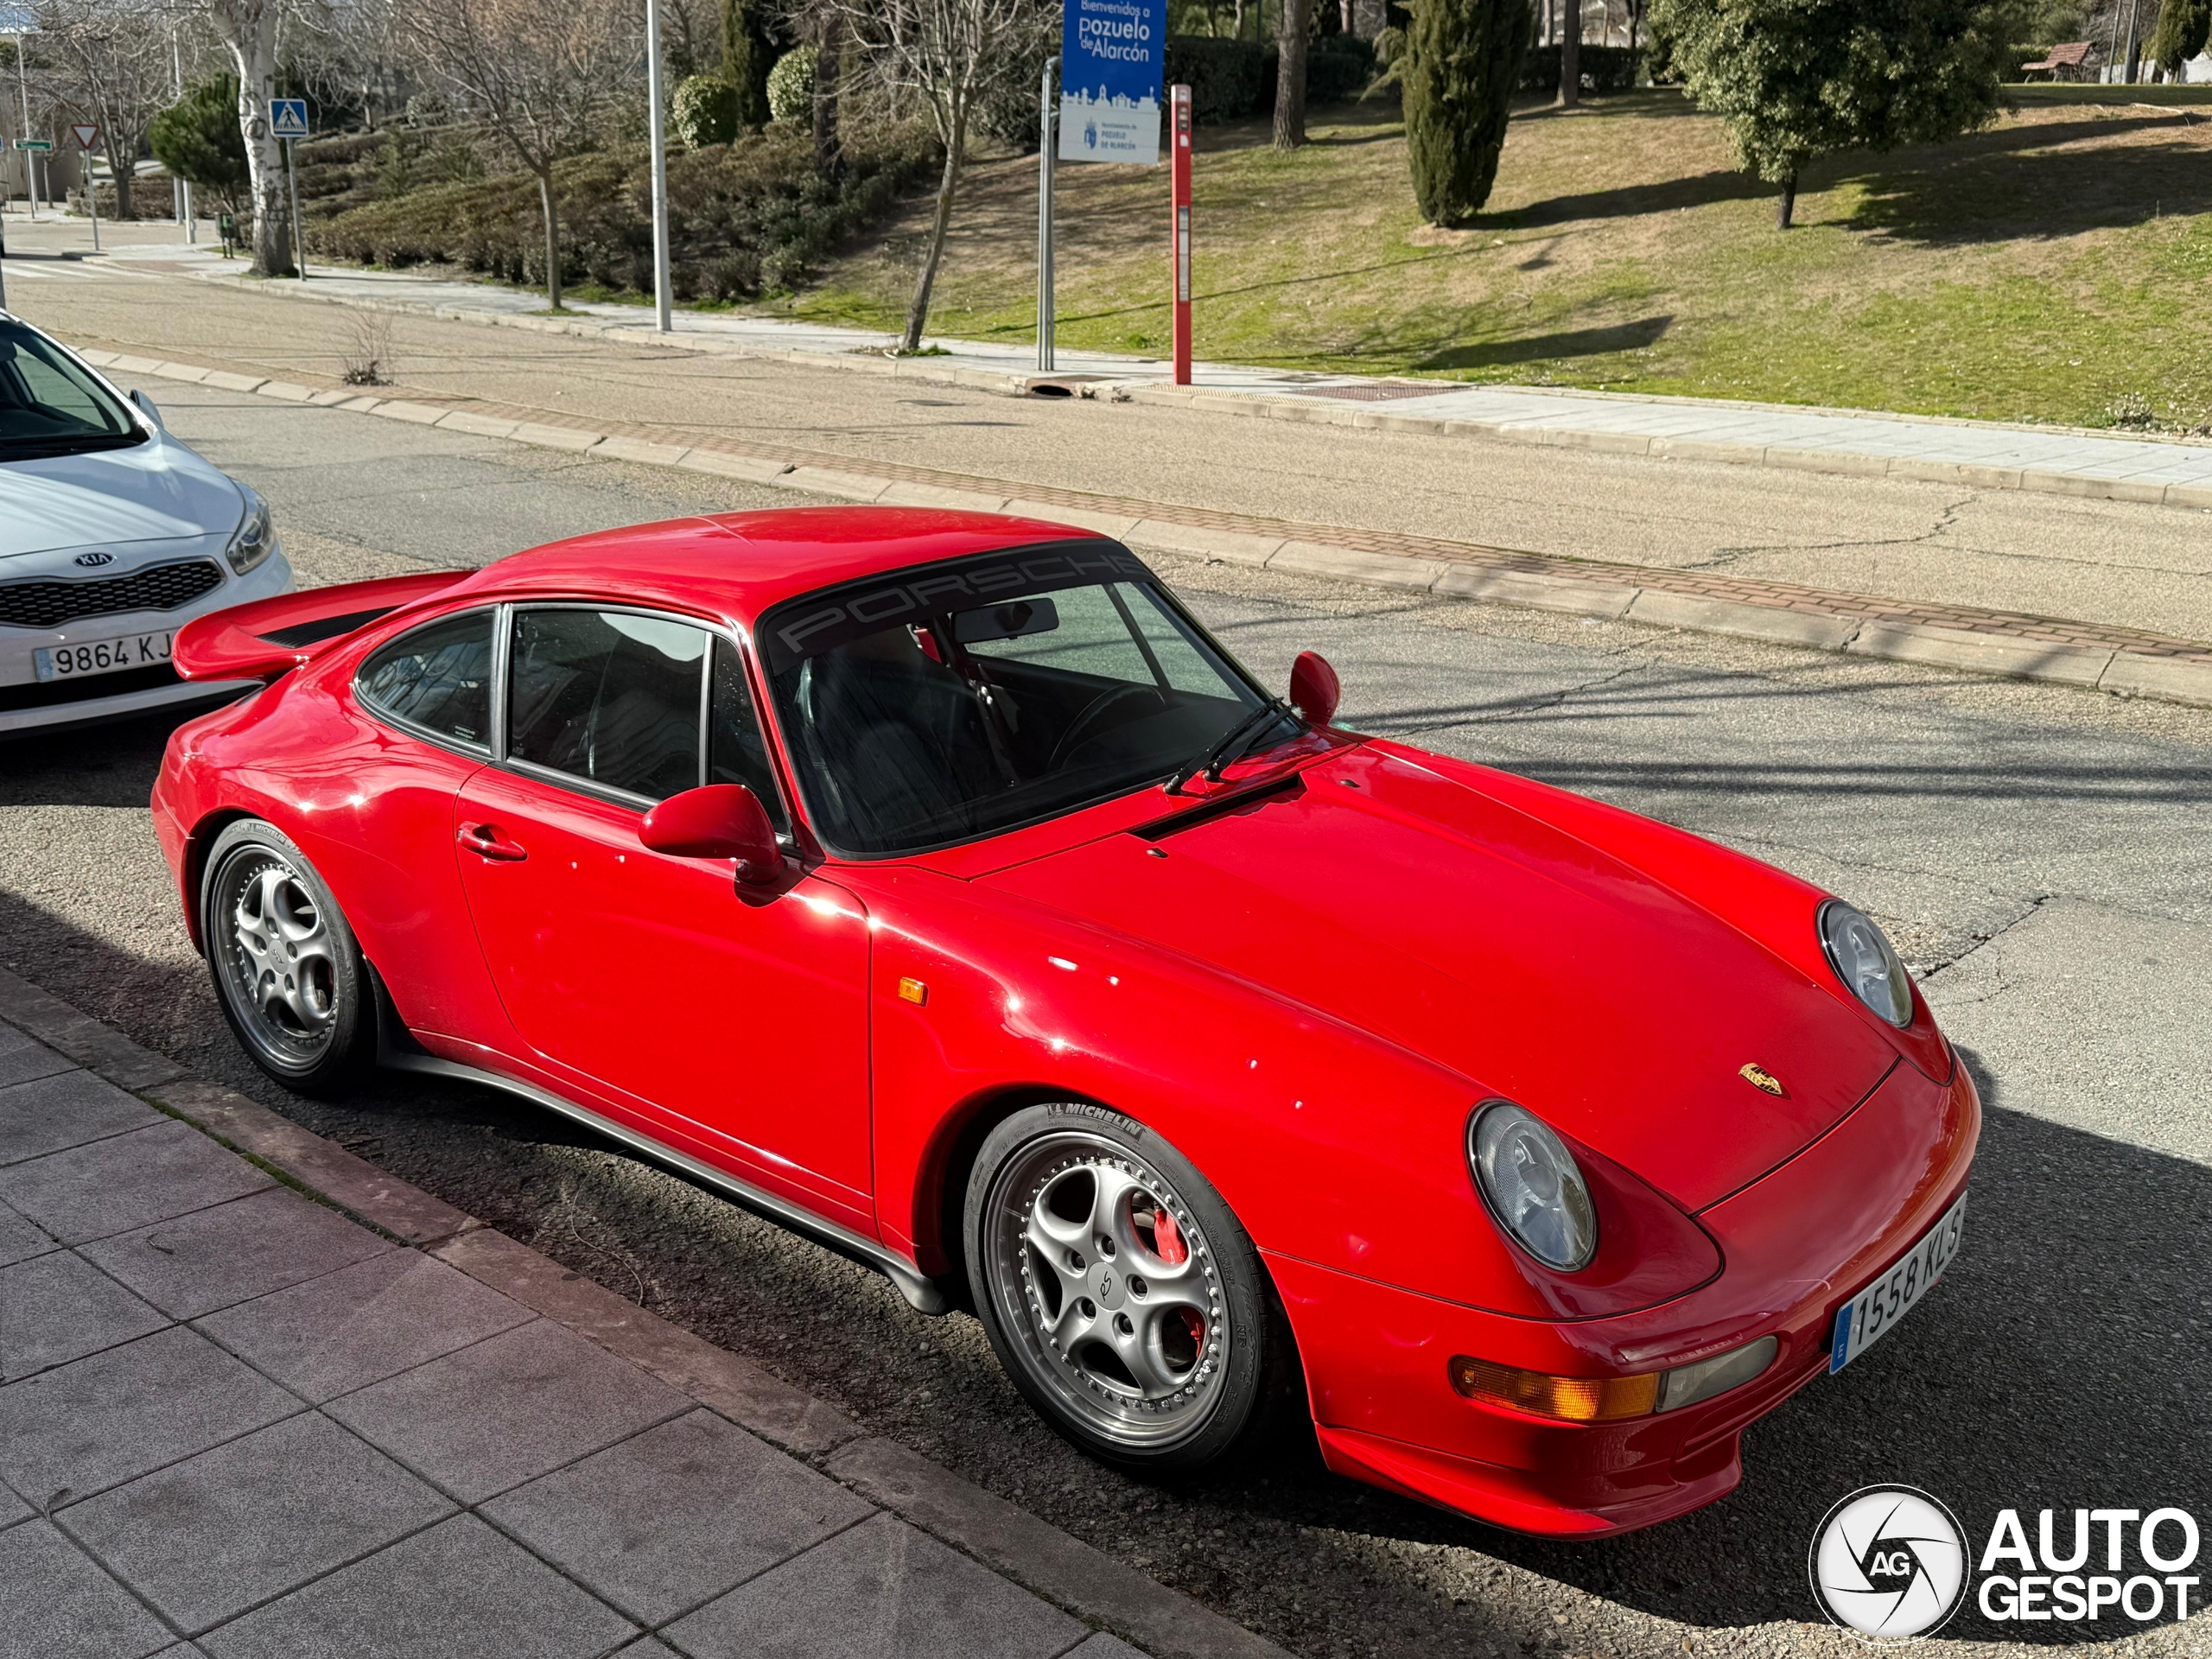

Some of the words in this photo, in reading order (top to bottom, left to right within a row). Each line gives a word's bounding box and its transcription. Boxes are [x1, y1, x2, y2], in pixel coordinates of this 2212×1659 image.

[1081, 0, 1141, 16] Bienvenidos
[1142, 8, 1150, 18] a
[1080, 35, 1094, 49] de
[1091, 37, 1149, 61] Alarcón
[79, 554, 110, 566] KIA
[777, 553, 1149, 654] PORSCHE
[56, 640, 130, 674] 9864
[138, 632, 173, 663] KJ
[255, 823, 288, 843] MICHELIN
[1065, 1103, 1141, 1136] MICHELIN
[1857, 1255, 1918, 1345] 1558
[1922, 1208, 1961, 1286] KLS
[1837, 1343, 1845, 1358] E
